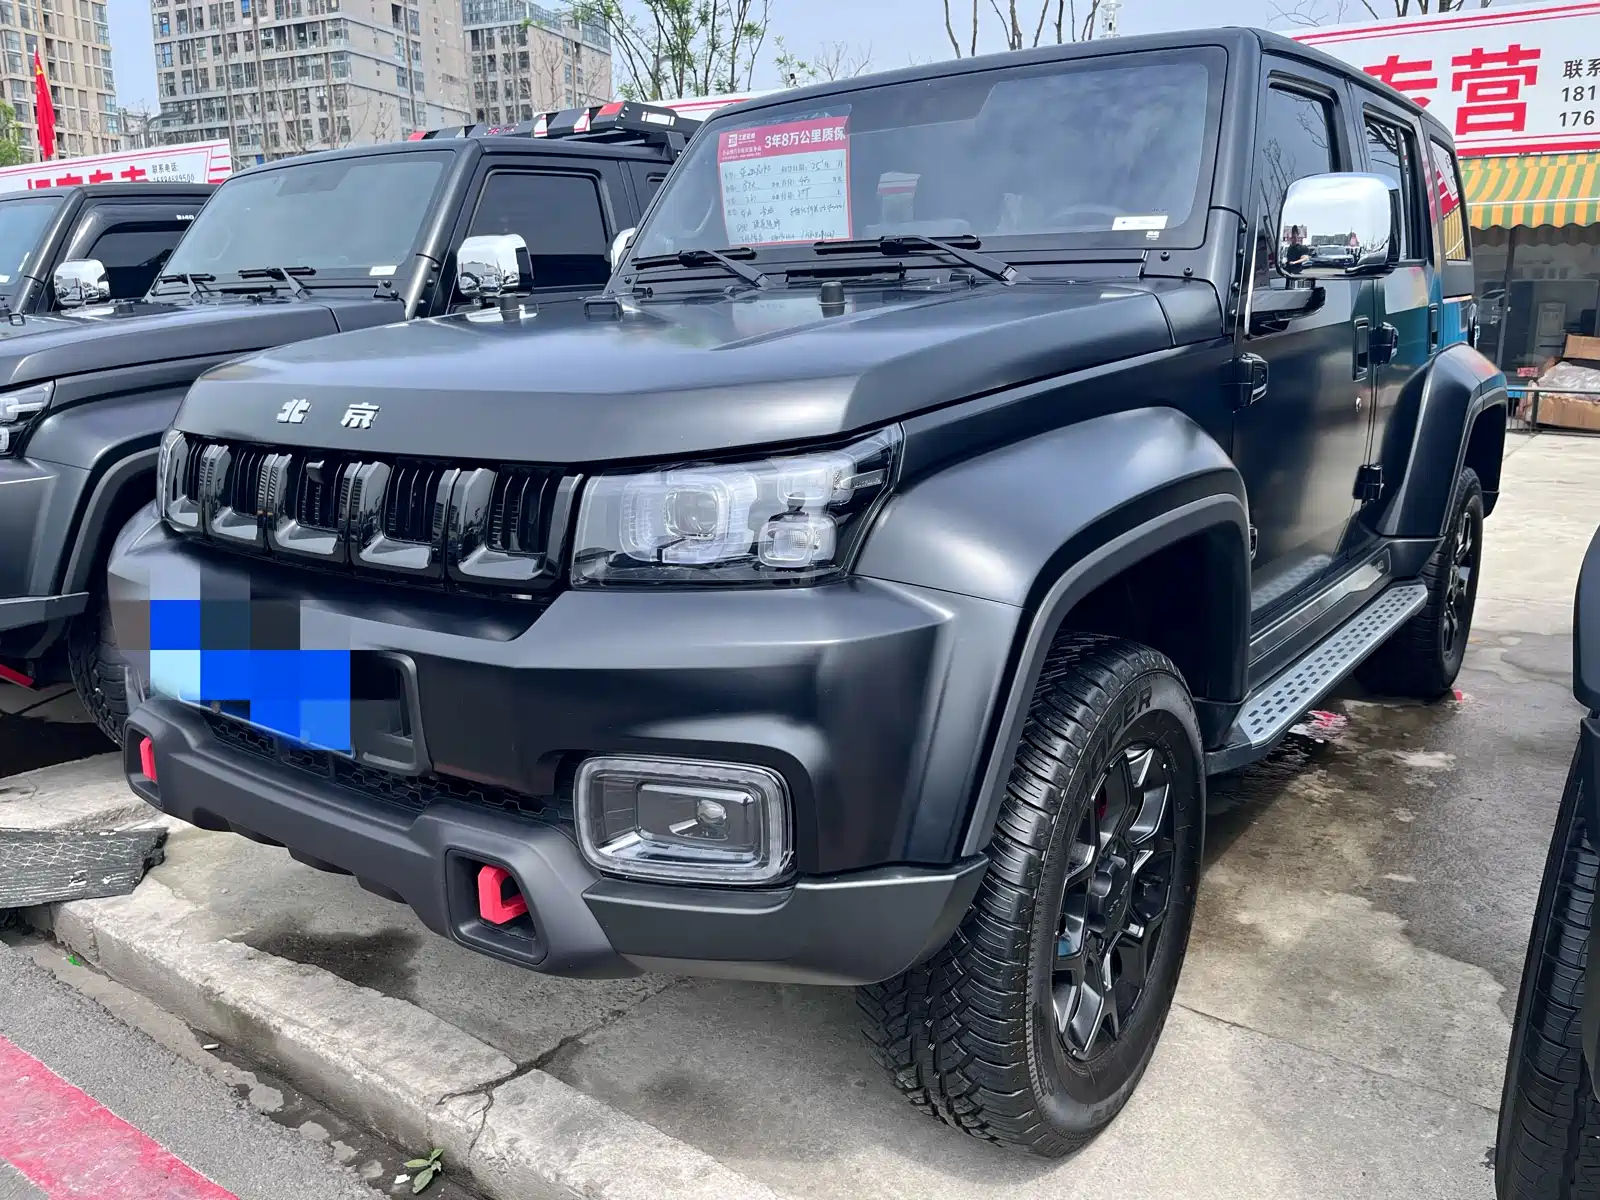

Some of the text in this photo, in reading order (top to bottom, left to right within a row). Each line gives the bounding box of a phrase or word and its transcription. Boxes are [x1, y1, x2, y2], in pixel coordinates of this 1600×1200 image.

[1562, 58, 1600, 79] 联系
[1561, 85, 1596, 102] 181
[1559, 110, 1595, 127] 176
[764, 126, 846, 149] 3年8万公里质保
[276, 398, 380, 430] 北京
